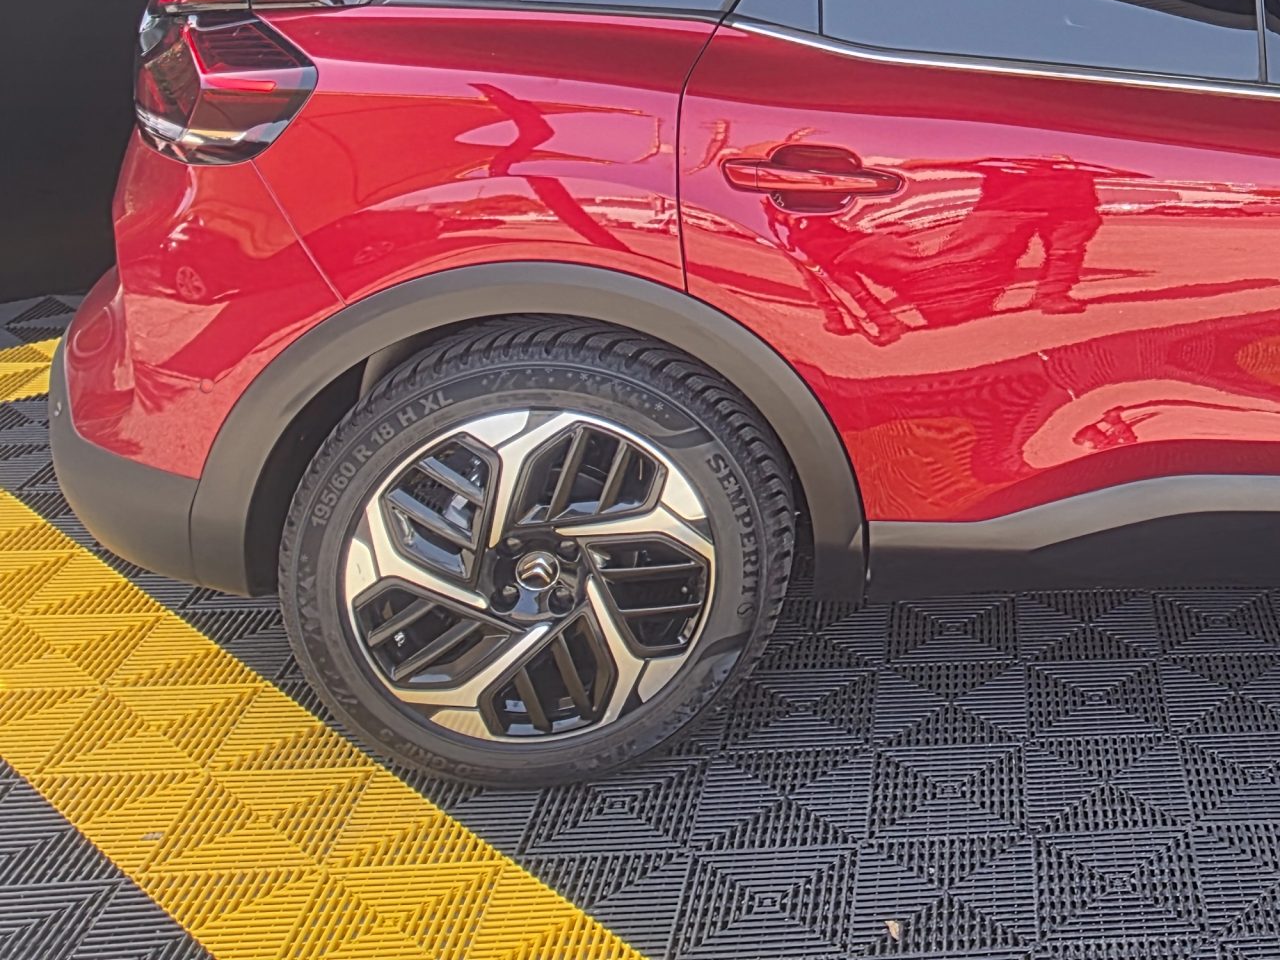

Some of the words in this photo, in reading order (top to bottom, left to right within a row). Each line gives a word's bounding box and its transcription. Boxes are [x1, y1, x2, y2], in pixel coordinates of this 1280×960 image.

[311, 461, 356, 528] 195/60
[352, 444, 374, 463] R
[370, 422, 395, 446] 18
[397, 407, 418, 427] H
[419, 390, 454, 415] XL
[705, 452, 760, 595] SEMPERIT
